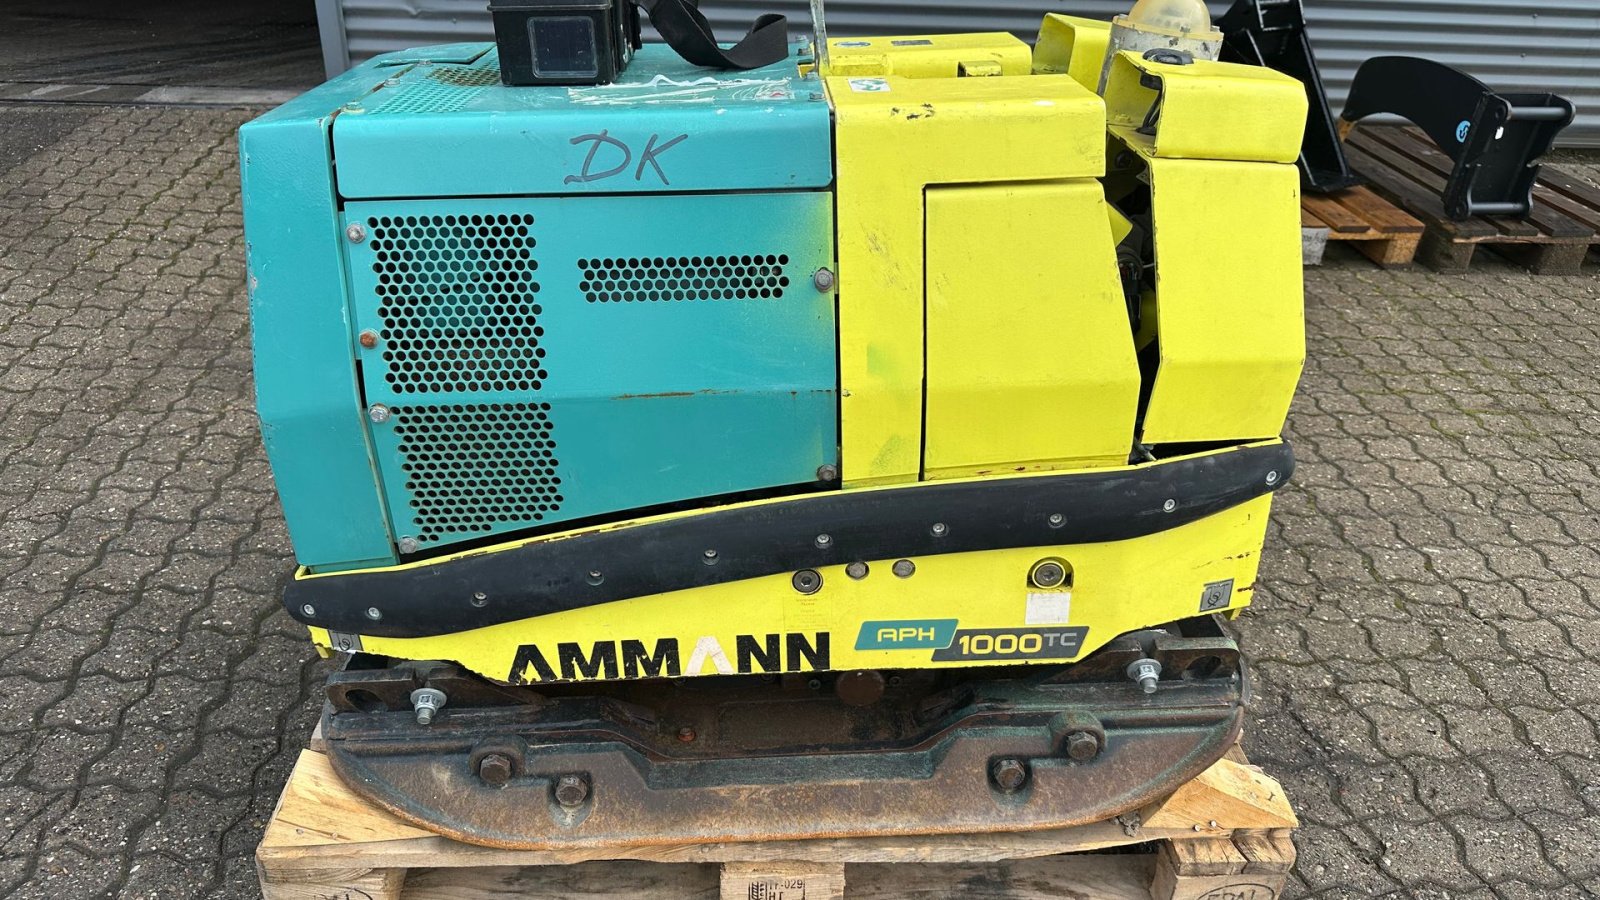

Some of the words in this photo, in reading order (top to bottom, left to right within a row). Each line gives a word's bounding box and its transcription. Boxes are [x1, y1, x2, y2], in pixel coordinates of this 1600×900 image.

[564, 129, 688, 185] DK
[507, 632, 830, 682] AMMANN
[877, 627, 935, 642] APH
